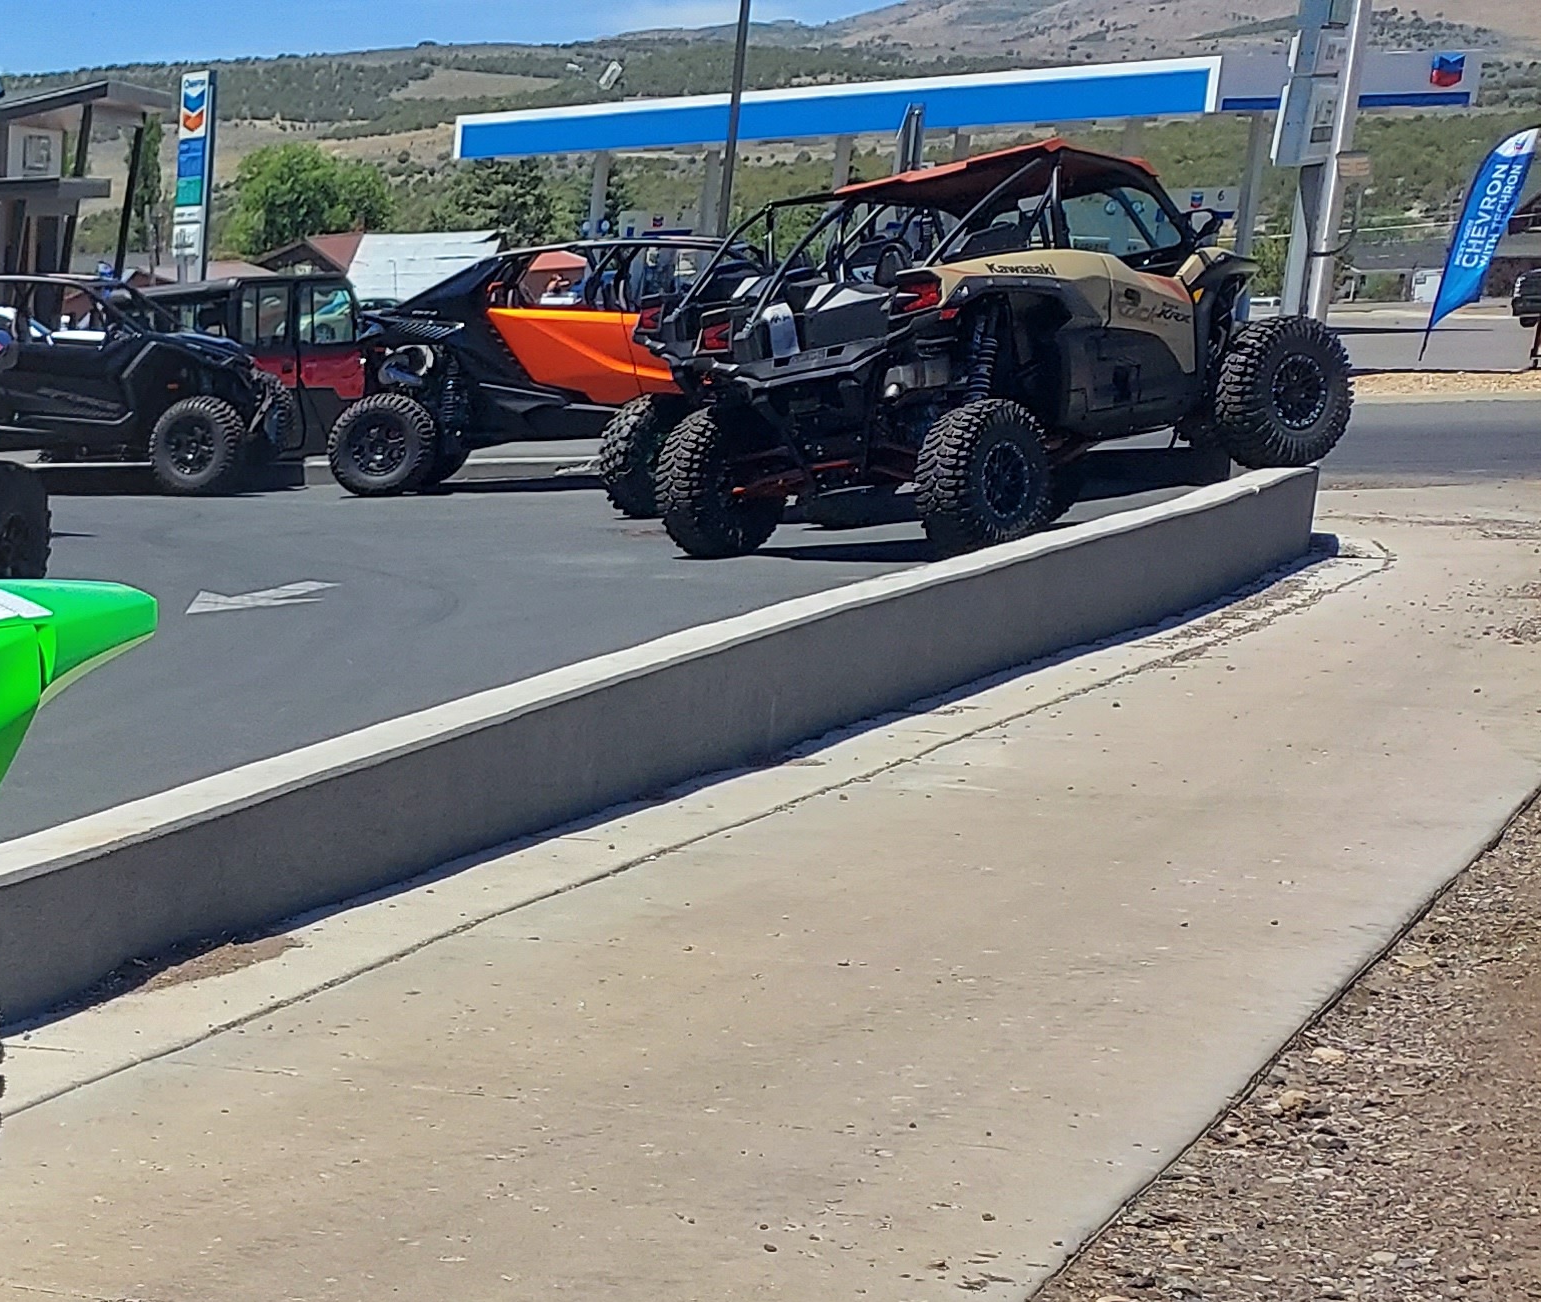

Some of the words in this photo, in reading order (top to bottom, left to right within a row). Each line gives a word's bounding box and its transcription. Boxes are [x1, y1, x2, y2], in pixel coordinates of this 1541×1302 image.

[1218, 190, 1225, 201] 6
[1462, 164, 1509, 268] CHEVRON
[1477, 234, 1500, 269] WITH
[1491, 164, 1524, 232] TECHRON
[985, 263, 1057, 276] Kawasaki
